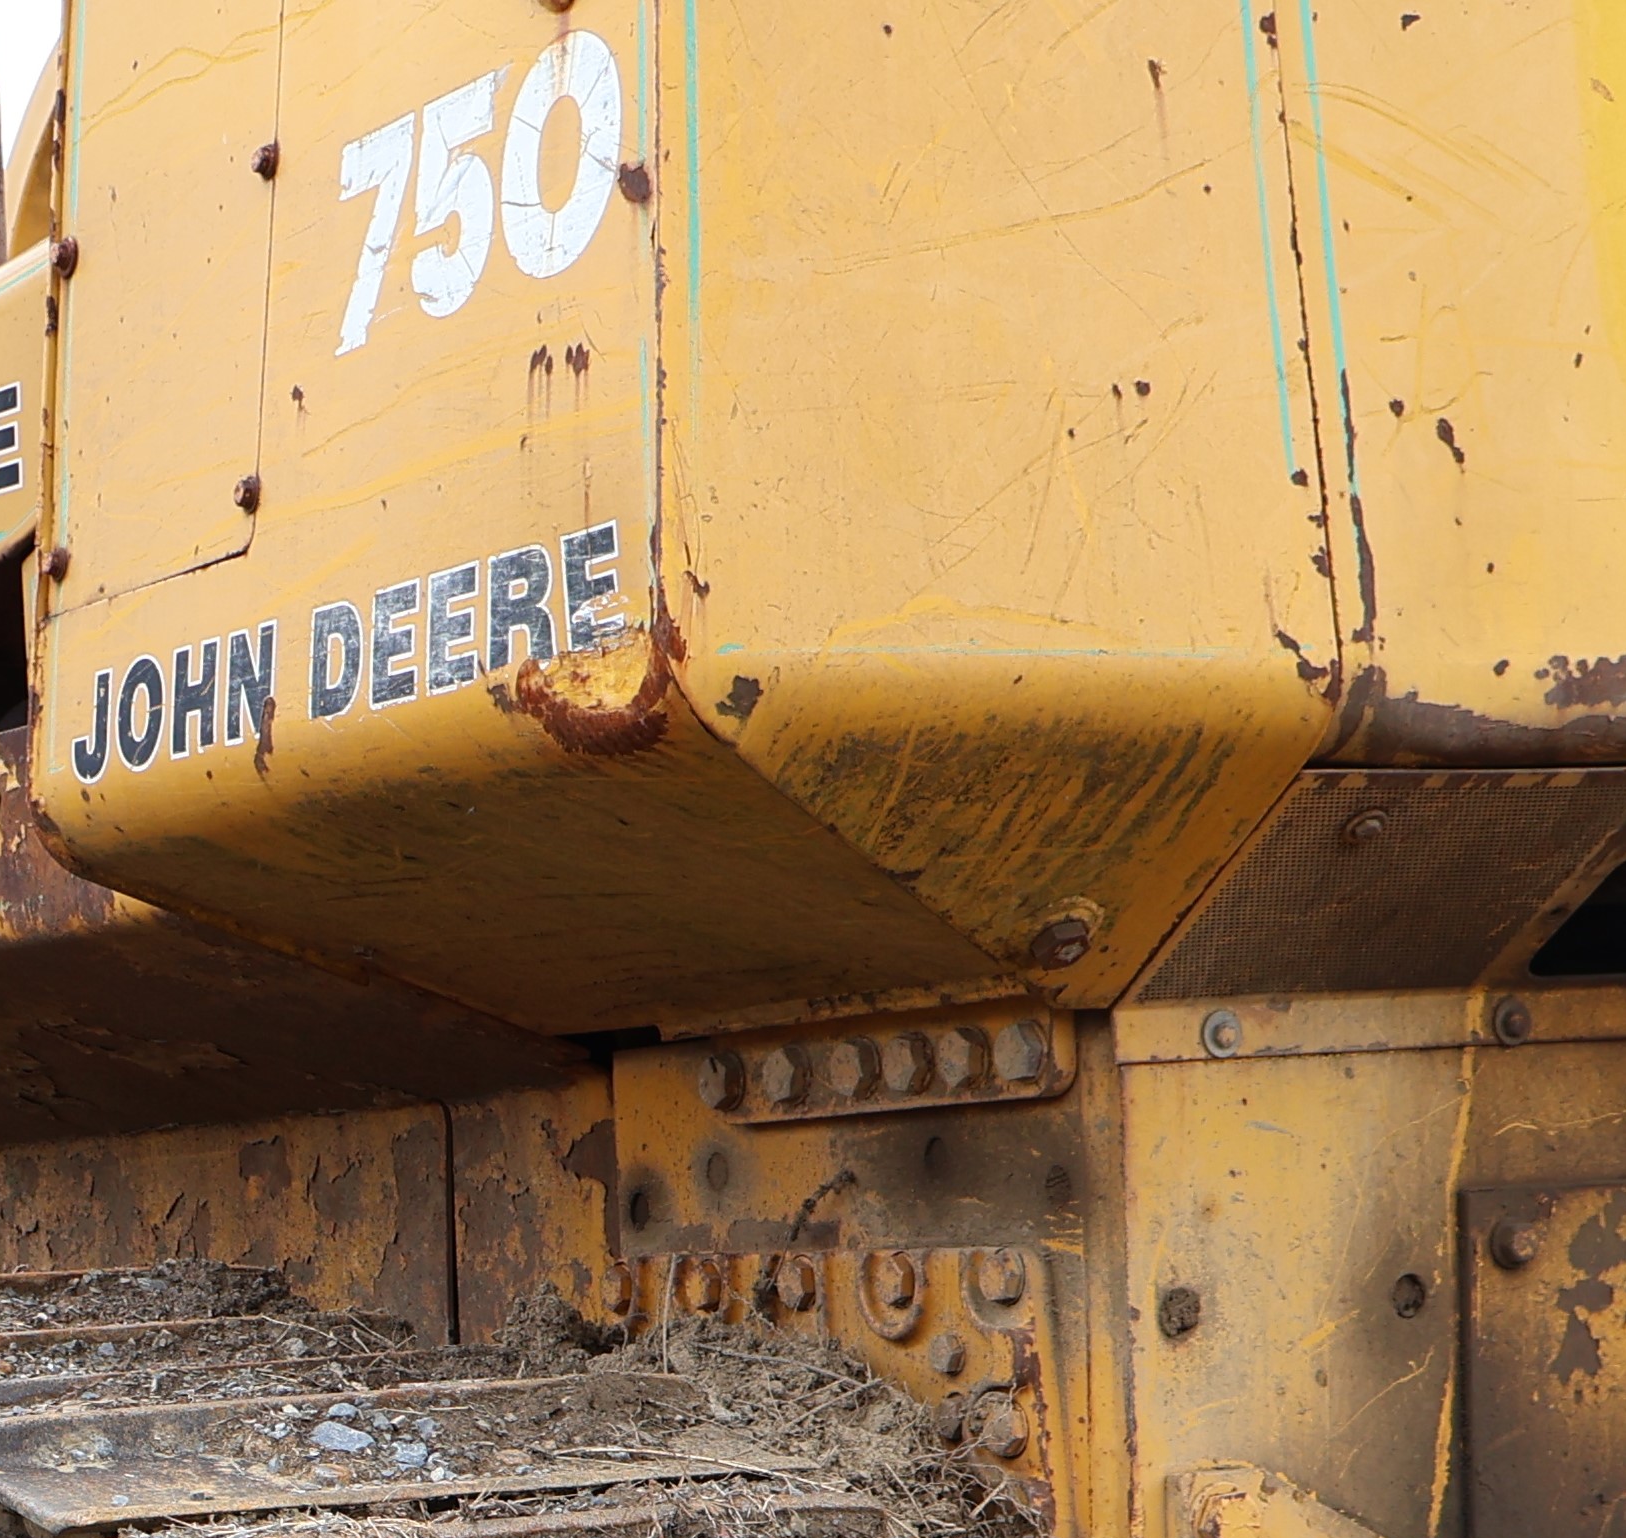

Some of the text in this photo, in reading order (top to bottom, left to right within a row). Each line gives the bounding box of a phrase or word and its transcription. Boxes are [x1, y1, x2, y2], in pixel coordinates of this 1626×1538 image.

[335, 29, 622, 356] 750
[72, 519, 623, 784] JOHN DEERE
